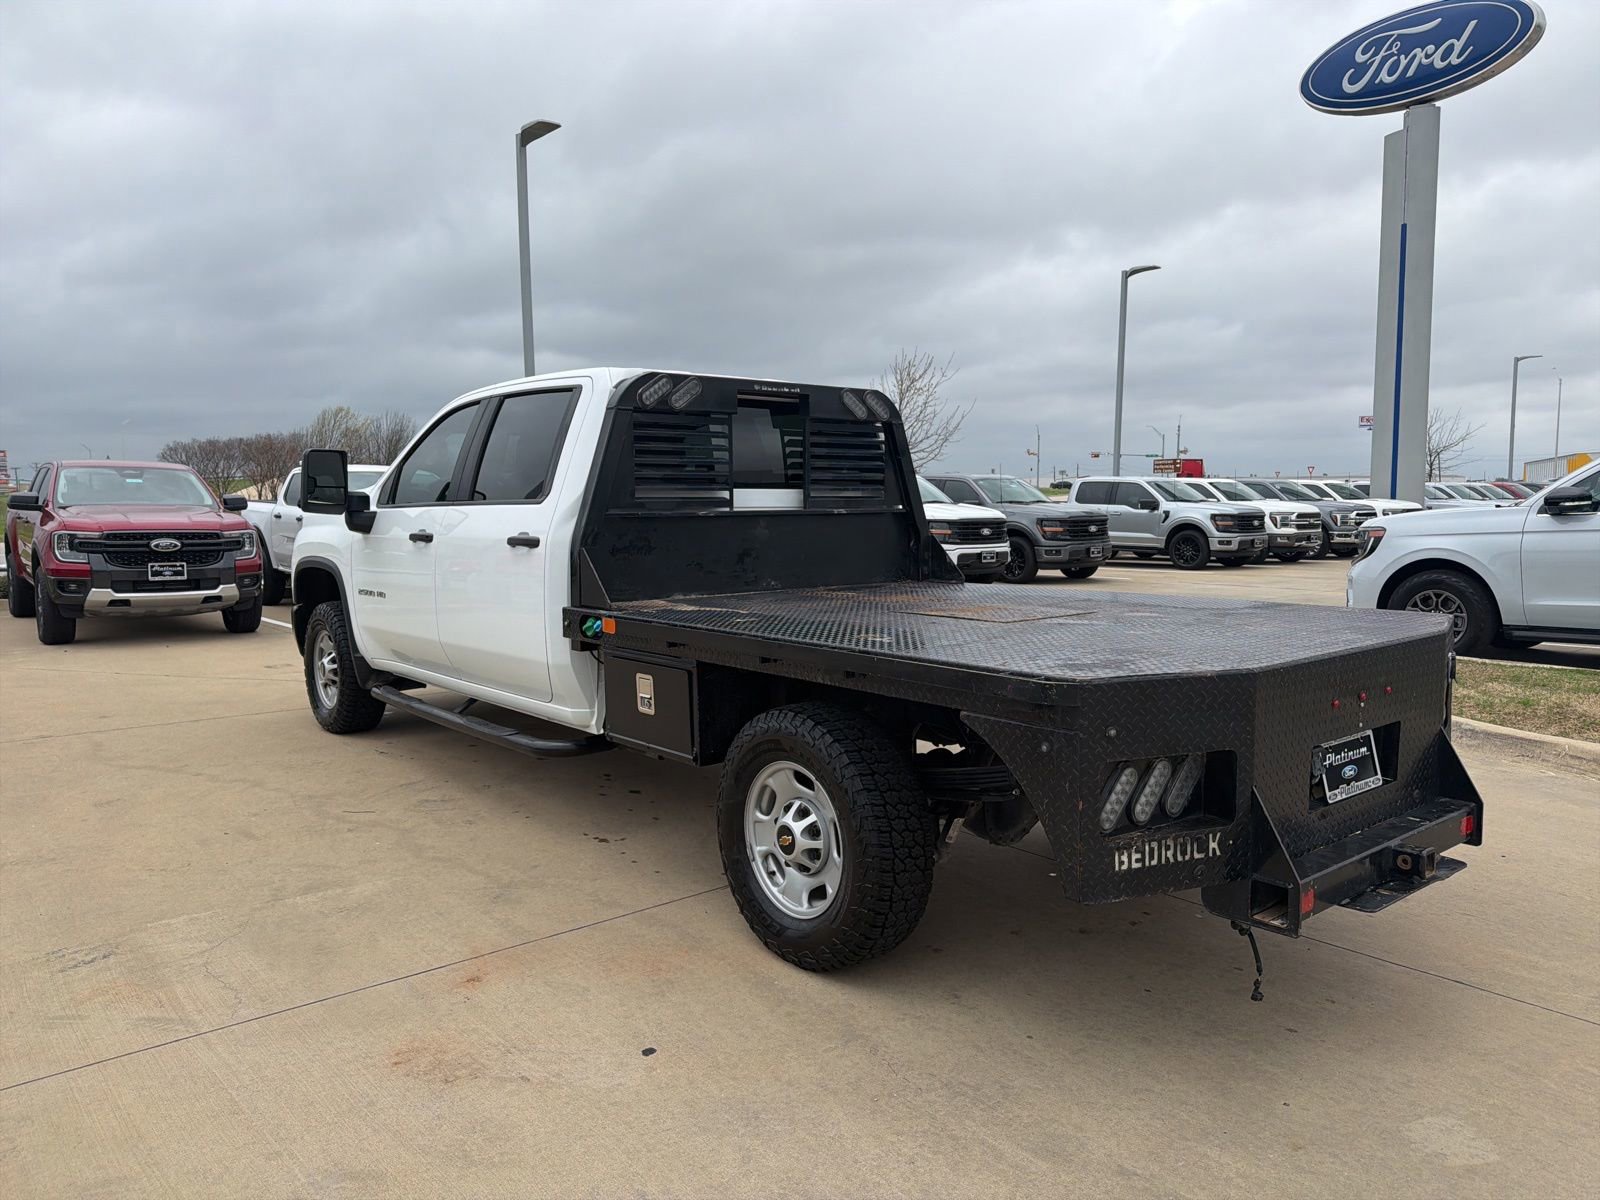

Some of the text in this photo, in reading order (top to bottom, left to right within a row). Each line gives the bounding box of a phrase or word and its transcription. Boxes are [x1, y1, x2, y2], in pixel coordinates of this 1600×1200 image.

[1342, 17, 1478, 94] Ford
[1323, 746, 1371, 768] Platinum
[1338, 781, 1372, 797] Platinum
[1114, 832, 1221, 872] BEDROCK
